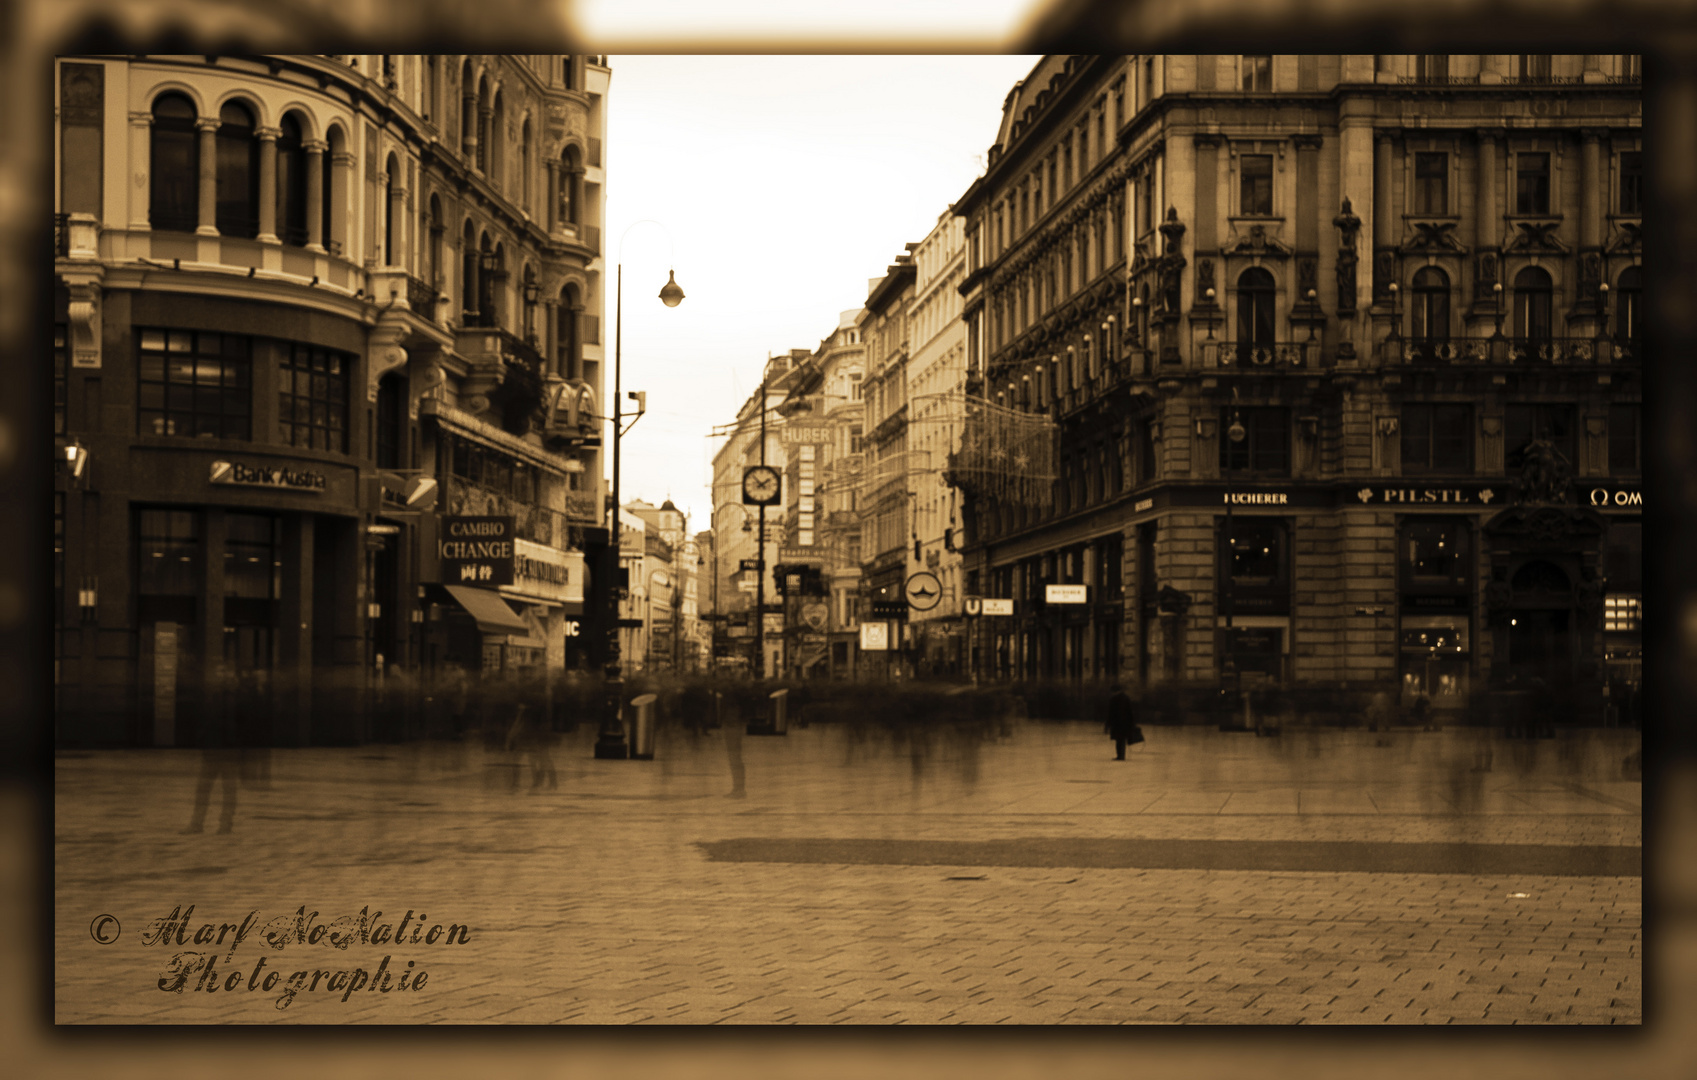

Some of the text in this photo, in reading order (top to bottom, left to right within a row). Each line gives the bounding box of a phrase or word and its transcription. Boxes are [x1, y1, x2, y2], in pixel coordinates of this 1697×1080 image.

[781, 427, 830, 443] HUBER
[233, 461, 327, 488] Bank Austria
[1384, 489, 1468, 502] PILSTL
[450, 522, 504, 536] CAMBIO
[442, 541, 511, 559] CHANGE
[965, 600, 980, 615] U
